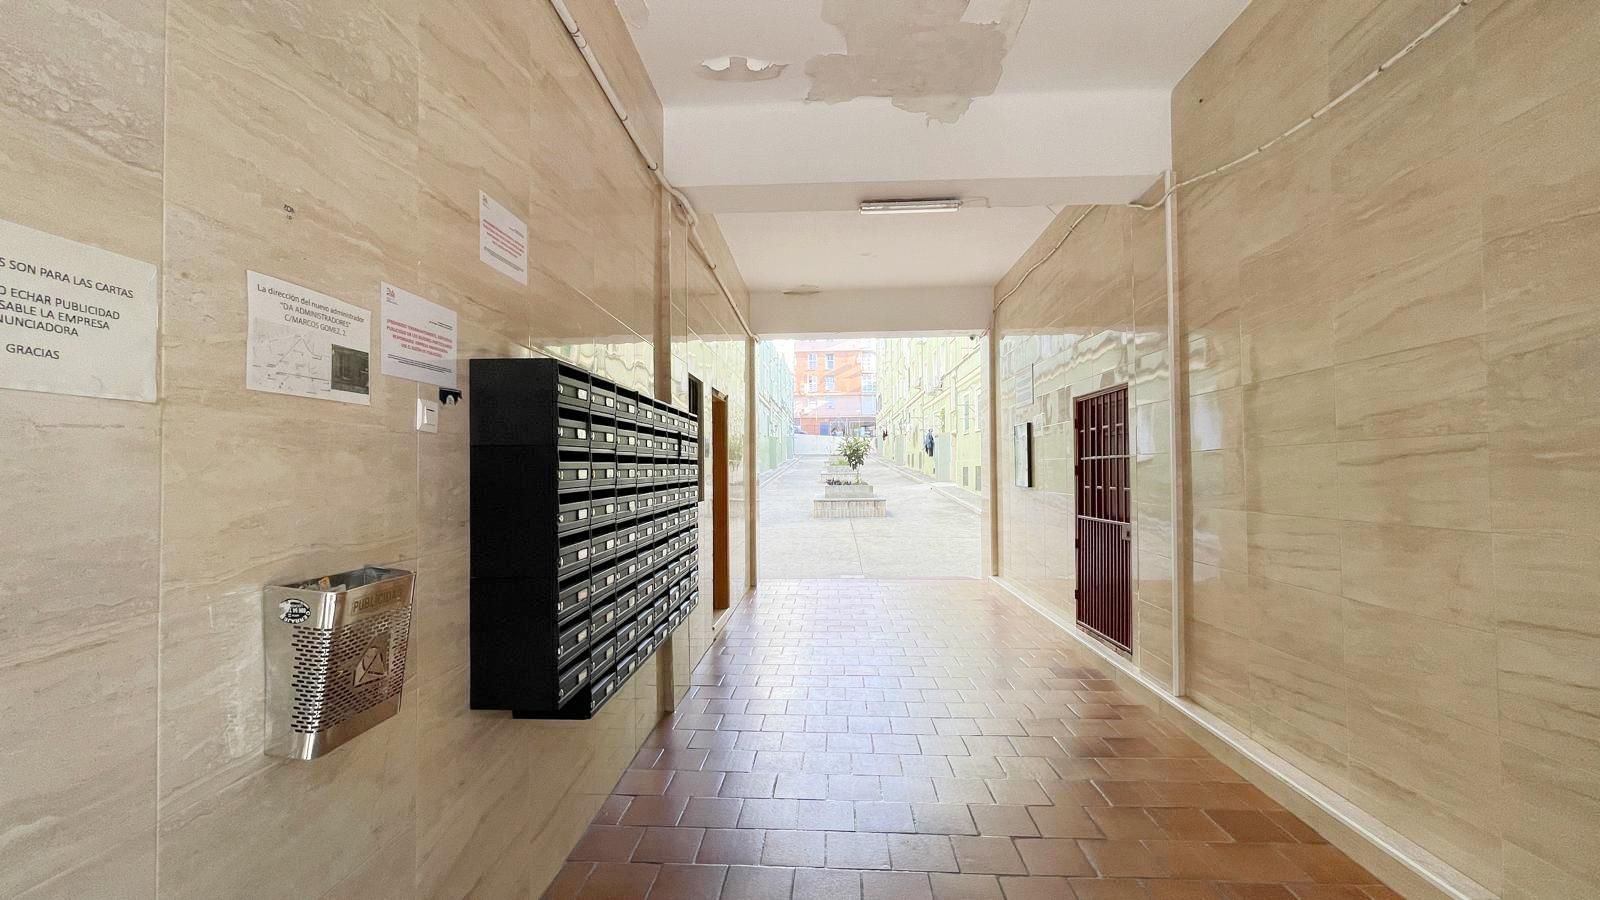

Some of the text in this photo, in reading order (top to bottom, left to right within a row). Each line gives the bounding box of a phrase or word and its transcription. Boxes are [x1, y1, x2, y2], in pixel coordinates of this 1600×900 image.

[9, 260, 36, 275] SON
[40, 267, 70, 284] PARA
[73, 276, 93, 289] LAS
[95, 282, 134, 299] CARTAS
[10, 287, 52, 306] ECHAR
[55, 298, 120, 320] PUBLICIDAD
[257, 284, 267, 293] La
[300, 299, 311, 309] del
[311, 302, 330, 312] nuevo
[330, 307, 365, 323] administrador
[40, 308, 55, 320] LA
[58, 312, 110, 331] EMPRESA
[284, 314, 320, 330] C/MARCOS
[6, 343, 60, 360] GRACIAS
